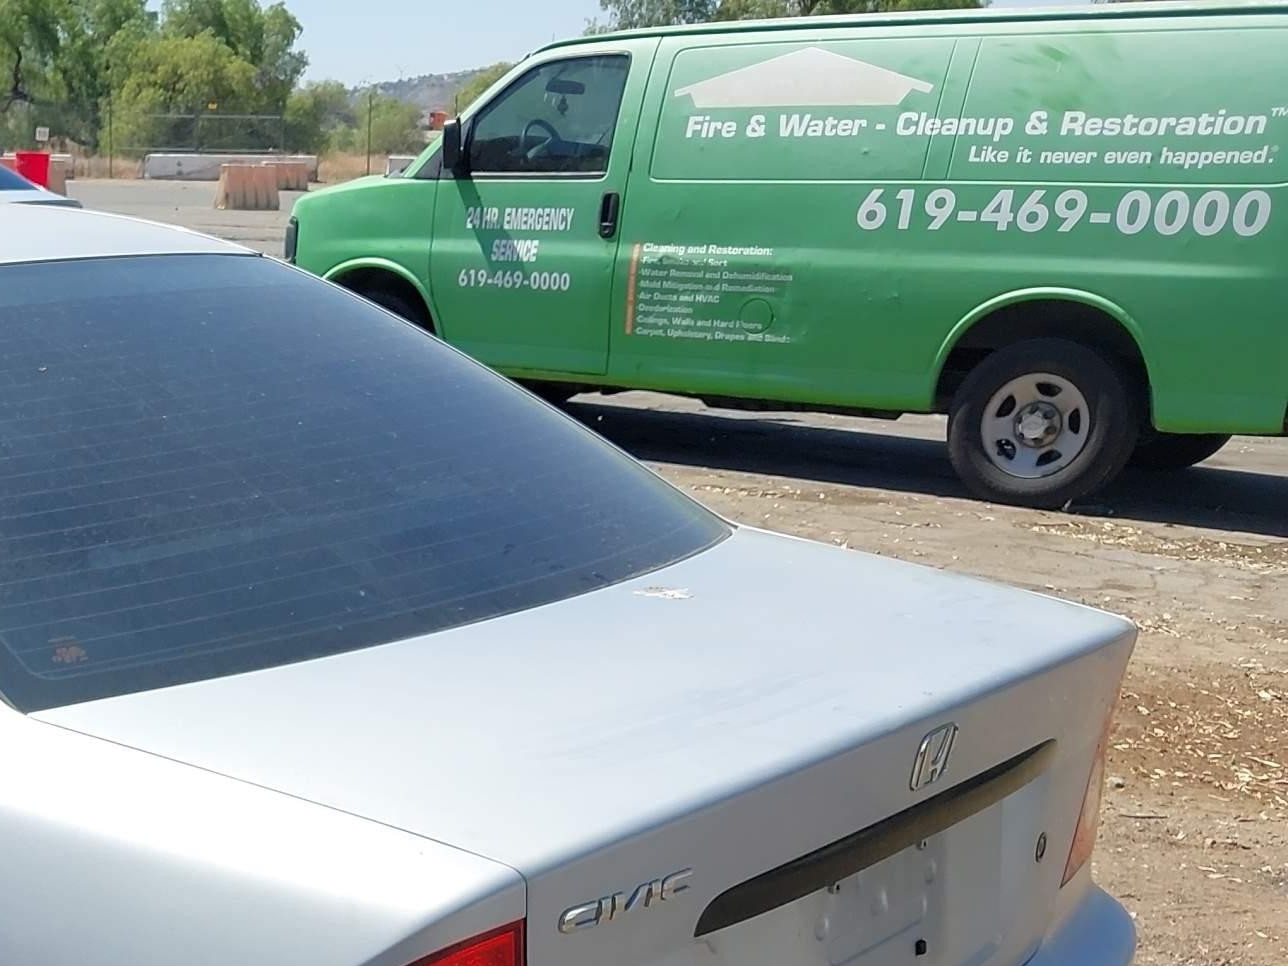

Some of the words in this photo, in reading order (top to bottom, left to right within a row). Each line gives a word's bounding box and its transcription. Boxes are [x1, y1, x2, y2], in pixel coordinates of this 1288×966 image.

[685, 114, 737, 138] Fire
[745, 114, 766, 138] &
[778, 113, 867, 137] Water
[896, 112, 1014, 142] Cleanup
[1024, 110, 1049, 135] &
[1060, 109, 1267, 136] Restoration
[968, 145, 1009, 164] Like
[1015, 146, 1032, 164] it
[1039, 150, 1097, 164] never
[1103, 150, 1152, 164] even
[465, 206, 481, 229] 24
[503, 207, 575, 231] EMERGENCY
[856, 188, 1272, 237] 619-469-0000
[491, 239, 540, 262] SERVICE
[643, 242, 685, 255] Cleaning
[687, 244, 707, 254] and
[708, 244, 773, 256] Restoration:
[458, 268, 570, 291] 619-469-0000
[695, 294, 720, 303] HVAC
[557, 867, 694, 935] CIVIC
